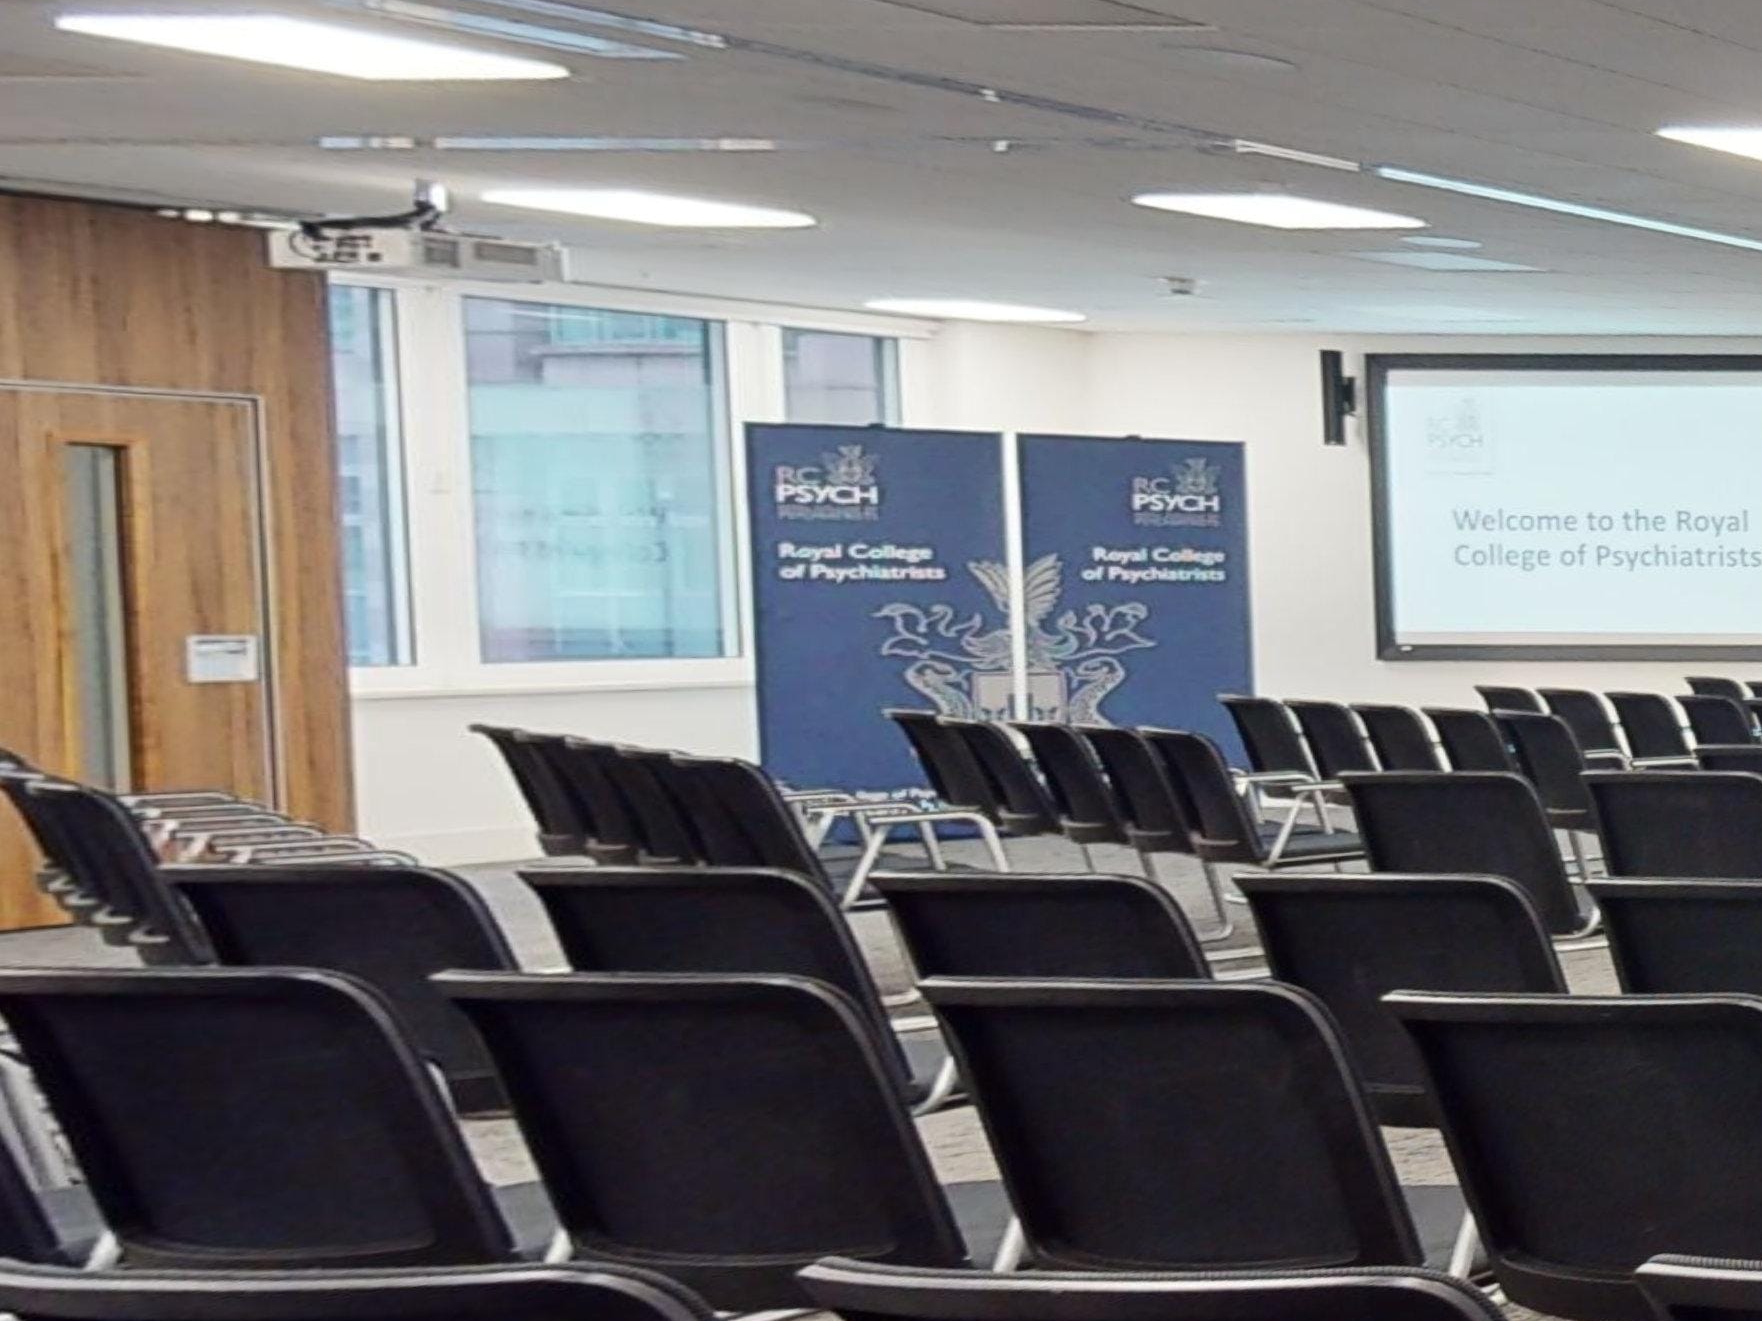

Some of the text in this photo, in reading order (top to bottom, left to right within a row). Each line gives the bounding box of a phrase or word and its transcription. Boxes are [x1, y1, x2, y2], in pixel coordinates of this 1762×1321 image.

[775, 466, 820, 484] RC
[1131, 476, 1170, 494] RC
[775, 485, 879, 505] PSYCH
[1131, 494, 1220, 512] PSYCH
[1453, 508, 1750, 539] Welcome to the Royal
[778, 542, 933, 563] Royal College
[1093, 547, 1226, 567] Royal College
[1454, 543, 1762, 572] College of Psychiatrists
[778, 563, 946, 585] of Psychiatrists
[1082, 565, 1227, 587] of Psychiatrists
